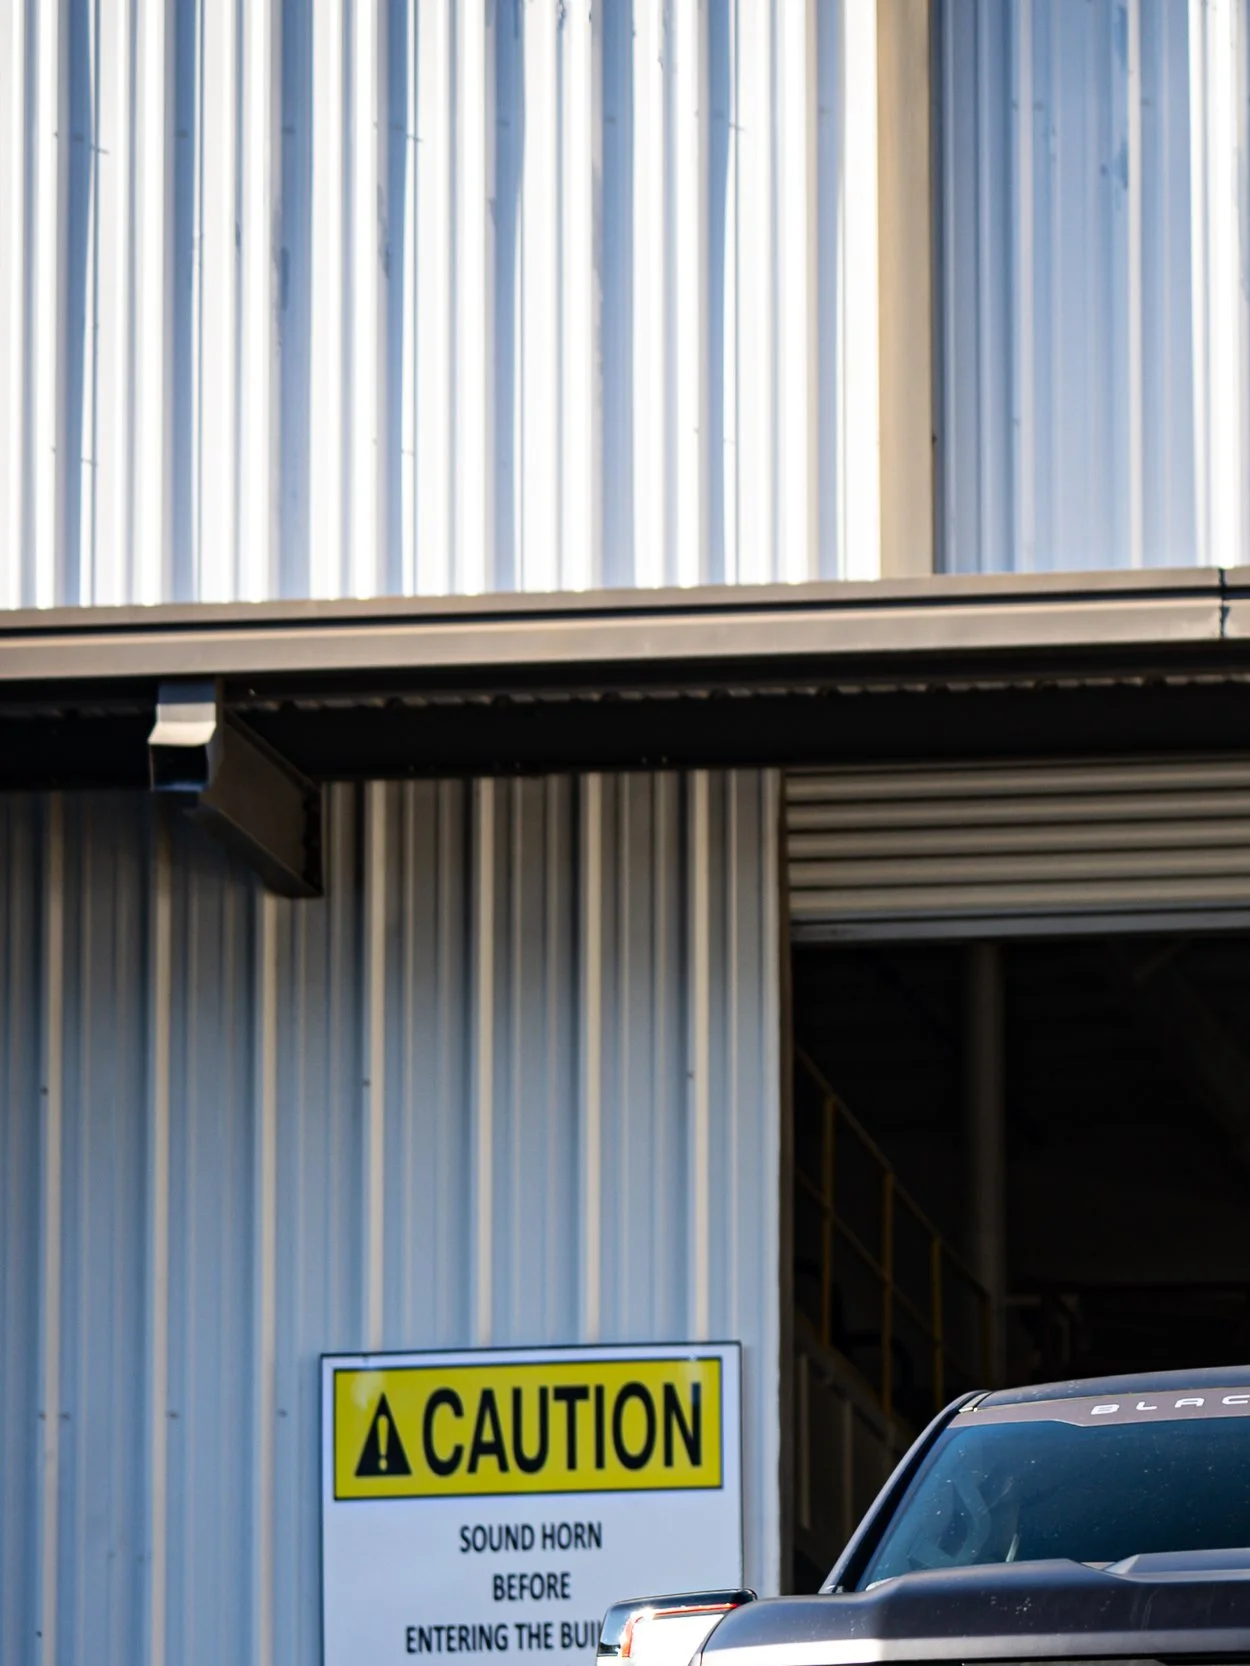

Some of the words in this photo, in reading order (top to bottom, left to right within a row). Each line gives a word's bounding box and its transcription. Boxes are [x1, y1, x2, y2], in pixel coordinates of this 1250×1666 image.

[422, 1380, 702, 1477] CAUTION
[459, 1523, 535, 1554] SOUND
[541, 1521, 602, 1551] HORN
[493, 1571, 571, 1601] BEFORE
[406, 1623, 512, 1654] ENTERING
[515, 1622, 554, 1651] THE
